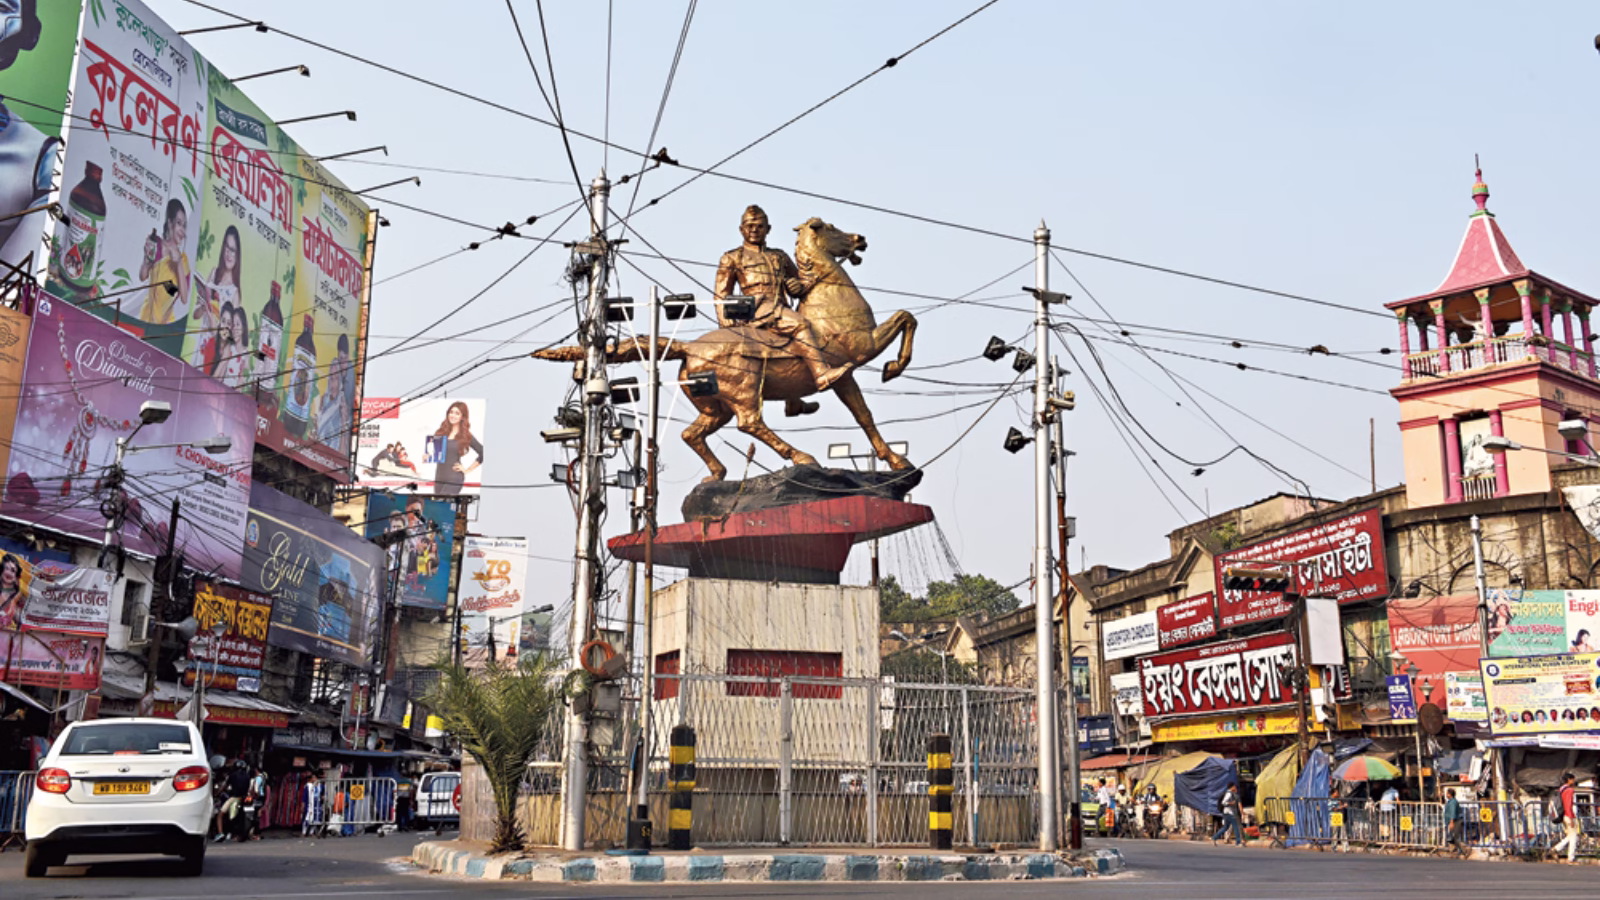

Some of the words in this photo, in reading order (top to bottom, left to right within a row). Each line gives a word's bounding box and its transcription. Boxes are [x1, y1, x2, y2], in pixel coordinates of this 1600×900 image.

[83, 37, 202, 178] কুলেরণ
[212, 126, 293, 234] ব্রেনোলিয়া
[75, 339, 167, 396] Diamonds
[108, 340, 151, 370] Dazzle
[260, 531, 310, 591] Gold
[486, 560, 511, 576] 70
[1393, 624, 1451, 647] LABORATORY
[1142, 658, 1187, 714] ইয়ং
[1184, 652, 1246, 709] বেঙ্গল
